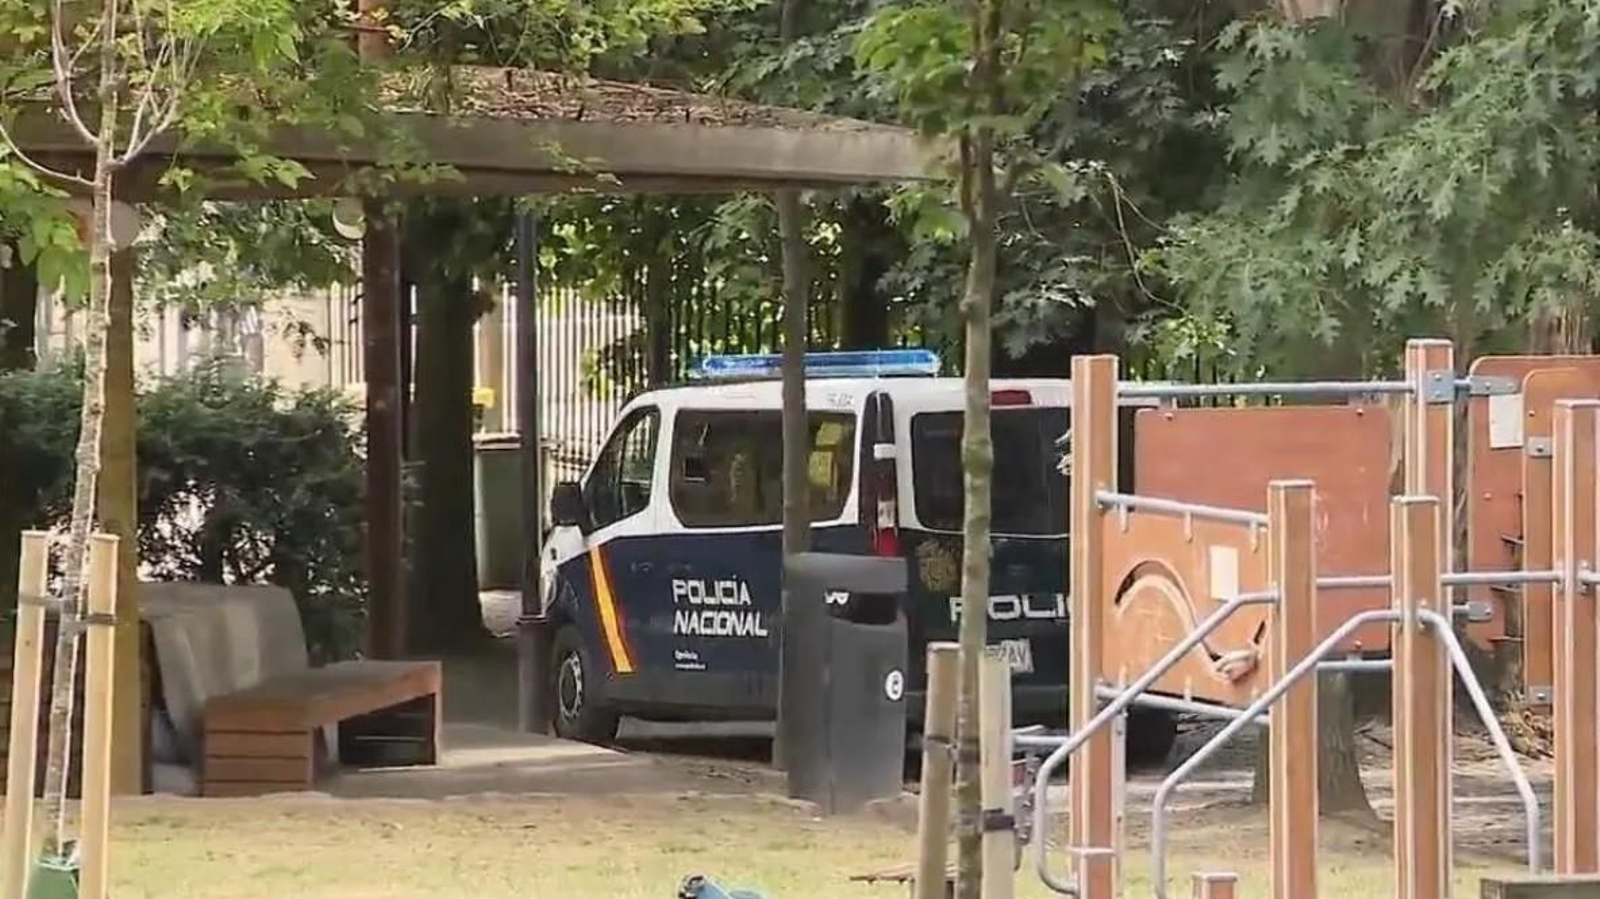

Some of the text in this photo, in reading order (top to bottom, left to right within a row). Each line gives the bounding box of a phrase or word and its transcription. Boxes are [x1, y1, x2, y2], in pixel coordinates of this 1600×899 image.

[672, 574, 752, 606] POLICÍA
[949, 594, 1070, 621] OLI
[673, 610, 768, 636] NACIONAL
